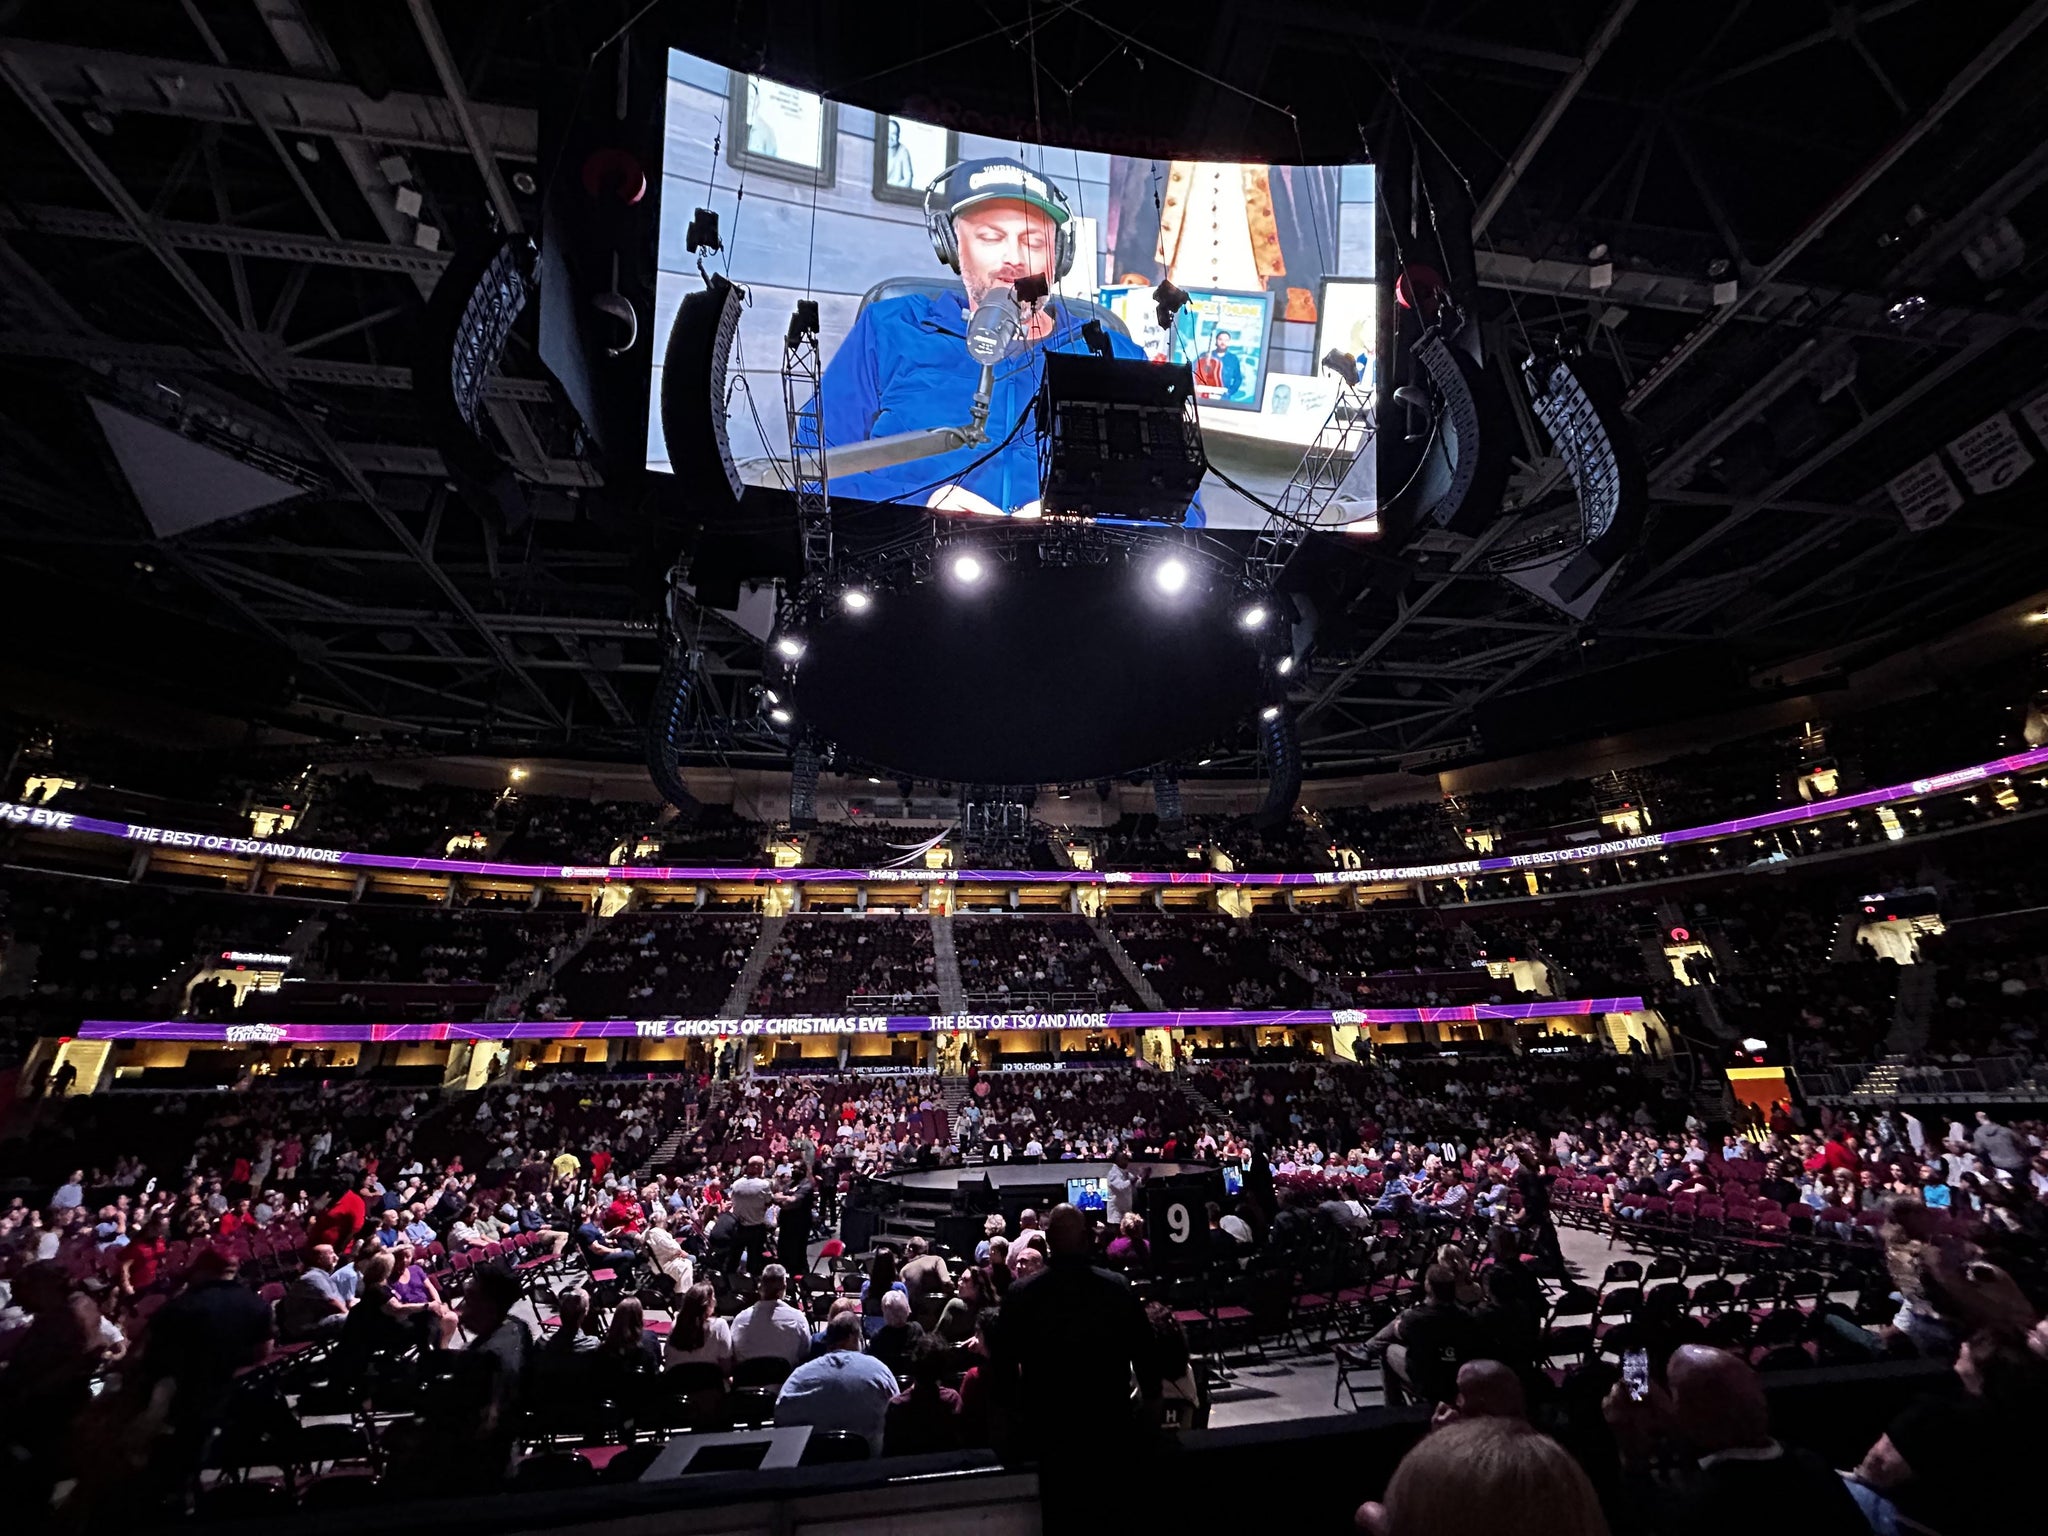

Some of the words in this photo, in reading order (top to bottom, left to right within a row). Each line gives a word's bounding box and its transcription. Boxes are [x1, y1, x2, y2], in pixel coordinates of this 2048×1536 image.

[31, 807, 75, 830] EVE
[126, 824, 162, 842] THE
[162, 828, 203, 847] BEST
[204, 835, 228, 849] OF
[229, 838, 261, 853] TSO
[259, 842, 295, 857] AND
[297, 847, 342, 863] MORE
[1510, 855, 1534, 866] THE
[1533, 852, 1559, 864] BEST
[1560, 849, 1574, 859] OF
[1575, 845, 1600, 858] TSO
[1600, 841, 1626, 854] AND
[1627, 834, 1662, 849] MORE
[869, 870, 899, 880] Friday,
[900, 870, 946, 880] December
[1313, 872, 1335, 883] THE
[1338, 870, 1378, 882] GHOSTS
[1380, 869, 1395, 880] OF
[1396, 862, 1458, 878] CHRISTMAS
[1459, 860, 1481, 872] EVE
[635, 1020, 668, 1036] THE
[673, 1019, 739, 1035] GHOSTS
[740, 1018, 764, 1034] OF
[765, 1017, 857, 1034] CHRISTMAS
[858, 1016, 888, 1032] EVE
[928, 1015, 955, 1030] THE
[957, 1015, 989, 1029] BEST
[990, 1015, 1008, 1028] OF
[1010, 1014, 1037, 1028] TSO
[1037, 1014, 1067, 1027] AND
[1069, 1013, 1107, 1026] MORE
[1440, 1142, 1457, 1162] 10
[145, 1176, 157, 1193] 6
[1166, 1203, 1190, 1243] 9
[1166, 1409, 1176, 1422] H
